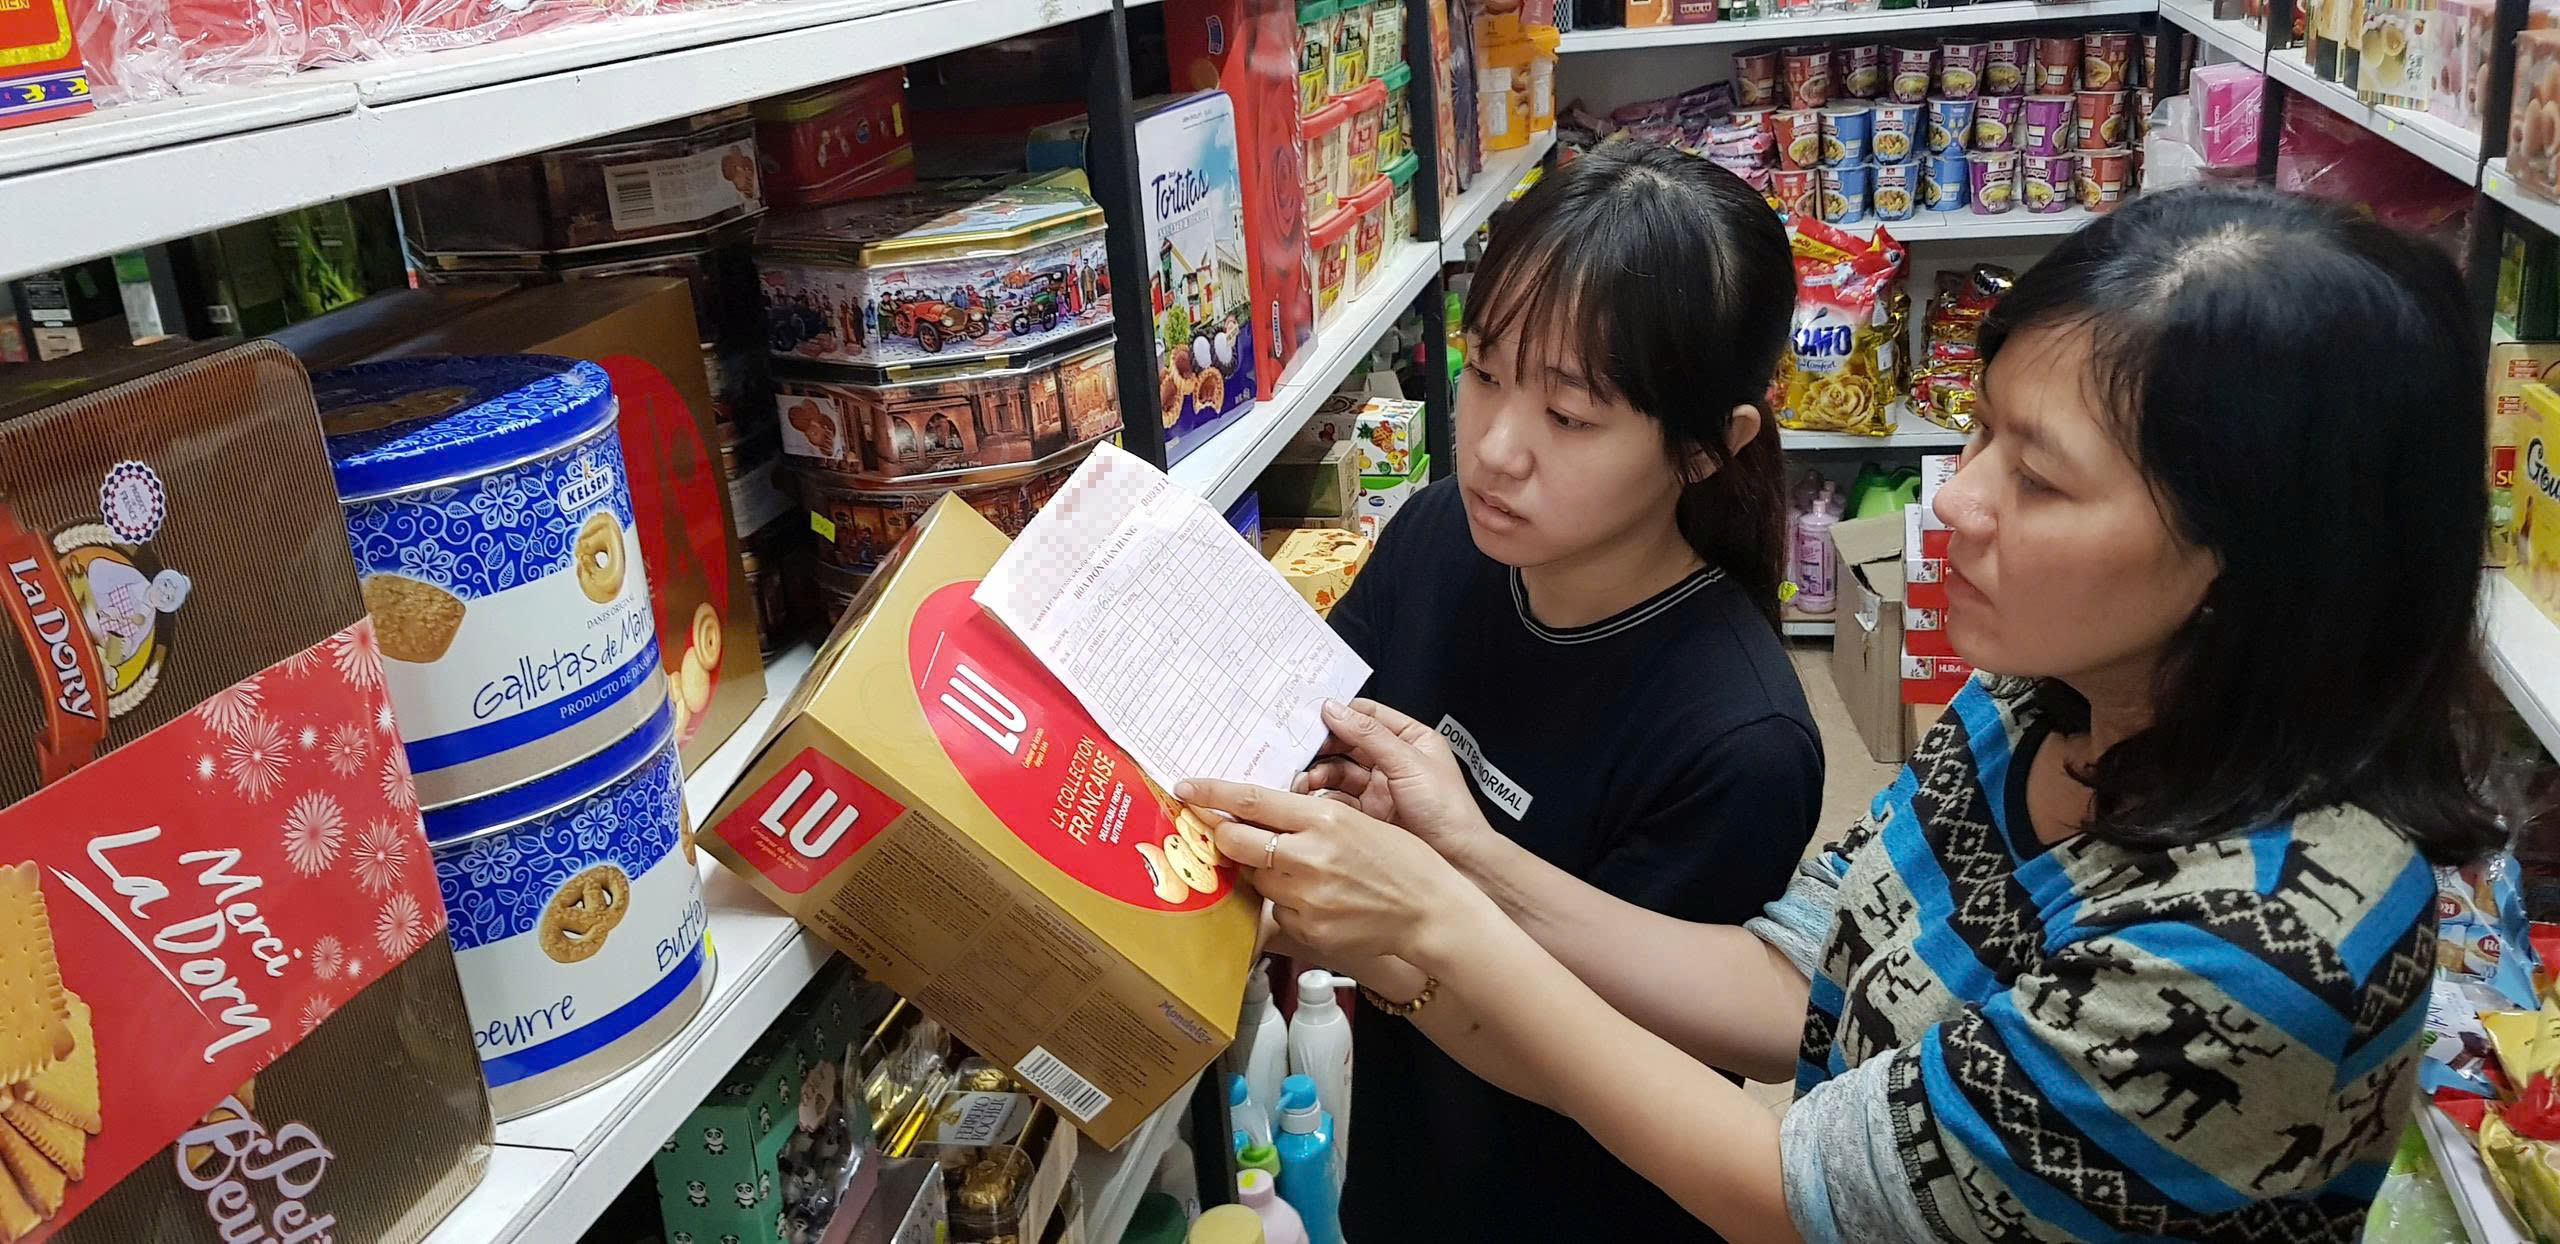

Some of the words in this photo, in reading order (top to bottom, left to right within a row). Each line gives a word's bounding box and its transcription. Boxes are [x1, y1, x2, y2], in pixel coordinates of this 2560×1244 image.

[1151, 167, 1210, 222] Tortitas
[1793, 324, 1854, 357] OMO
[566, 476, 611, 505] KELSEN
[2527, 437, 2560, 502] Gou
[473, 643, 598, 719] Galletas
[601, 633, 617, 665] de
[559, 680, 620, 719] PRODUCTO
[619, 671, 634, 688] DE
[939, 662, 1029, 756] LU
[1440, 723, 1474, 757] DON'T
[1055, 733, 1096, 810] COLLECTION
[1065, 748, 1117, 844] FRANÇAISE
[757, 767, 861, 861] LU
[1048, 805, 1069, 829] LA
[1097, 802, 1117, 842] DELECTABLE
[1109, 779, 1125, 805] FRENCH
[1109, 817, 1123, 844] BUTTER
[1117, 792, 1132, 821] COOKIES
[86, 825, 170, 920] La
[153, 908, 272, 1064] Dory
[178, 847, 303, 978] Merci
